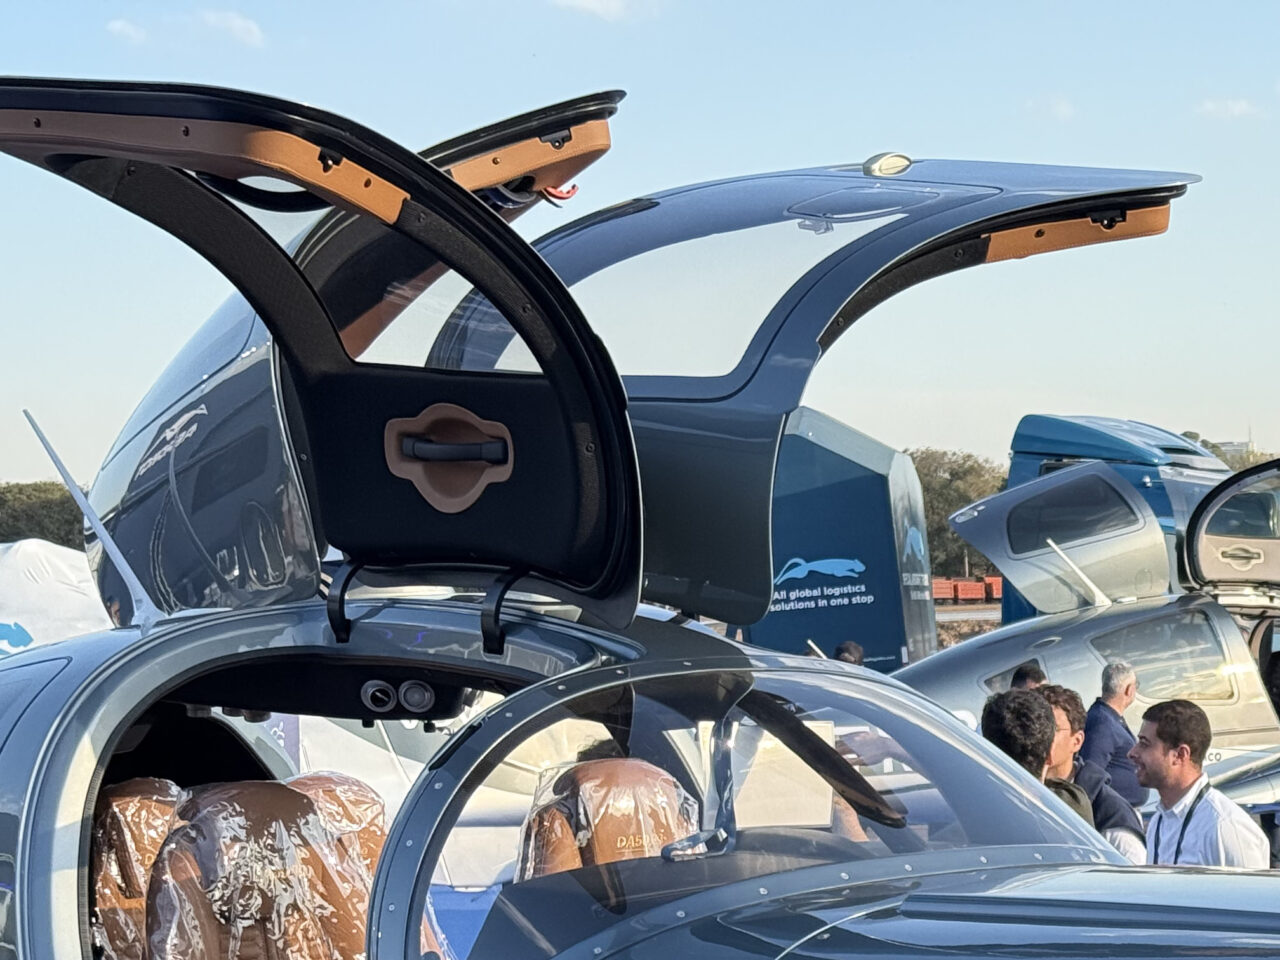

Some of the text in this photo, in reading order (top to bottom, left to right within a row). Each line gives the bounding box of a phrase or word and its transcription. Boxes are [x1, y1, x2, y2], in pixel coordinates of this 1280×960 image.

[773, 584, 866, 601] All global logistics
[770, 594, 874, 612] solutions in one stop
